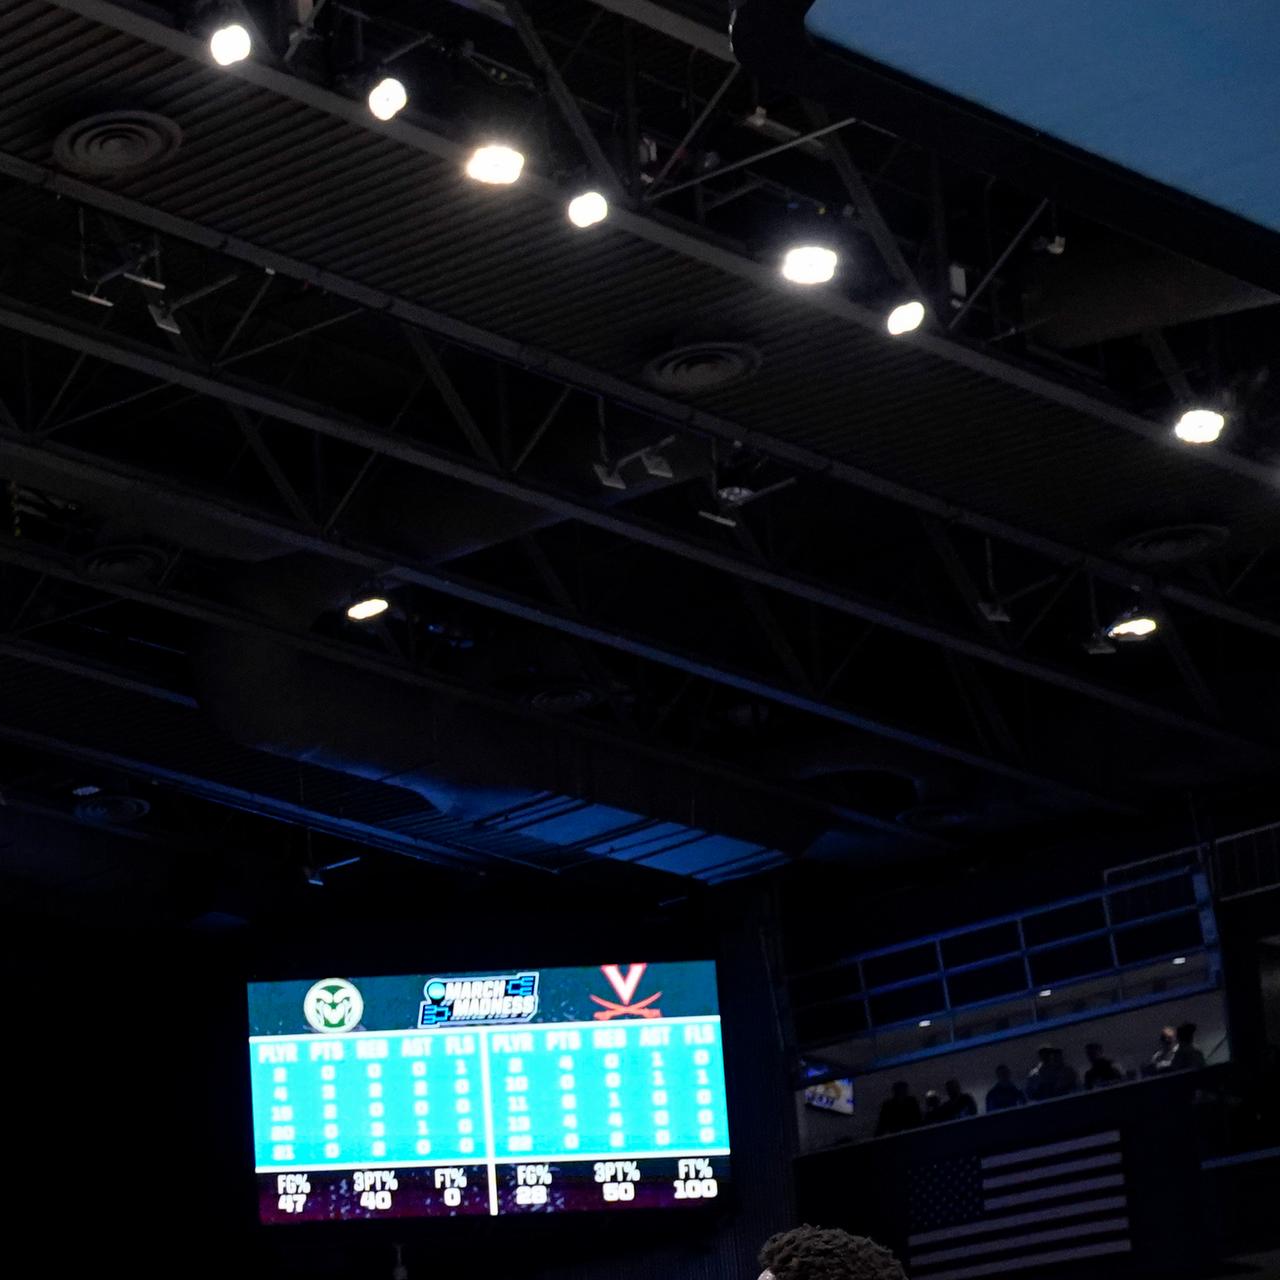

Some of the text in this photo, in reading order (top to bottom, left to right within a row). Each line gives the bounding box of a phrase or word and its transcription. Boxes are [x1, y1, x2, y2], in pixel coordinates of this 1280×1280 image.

[444, 979, 506, 1001] MARCH
[452, 995, 537, 1018] MADNESS
[277, 1168, 468, 1195] FG% 3PT% FT%
[516, 1158, 714, 1185] FG% 3PT% FT%
[277, 1188, 461, 1213] 47 40 0
[673, 1178, 718, 1199] 100
